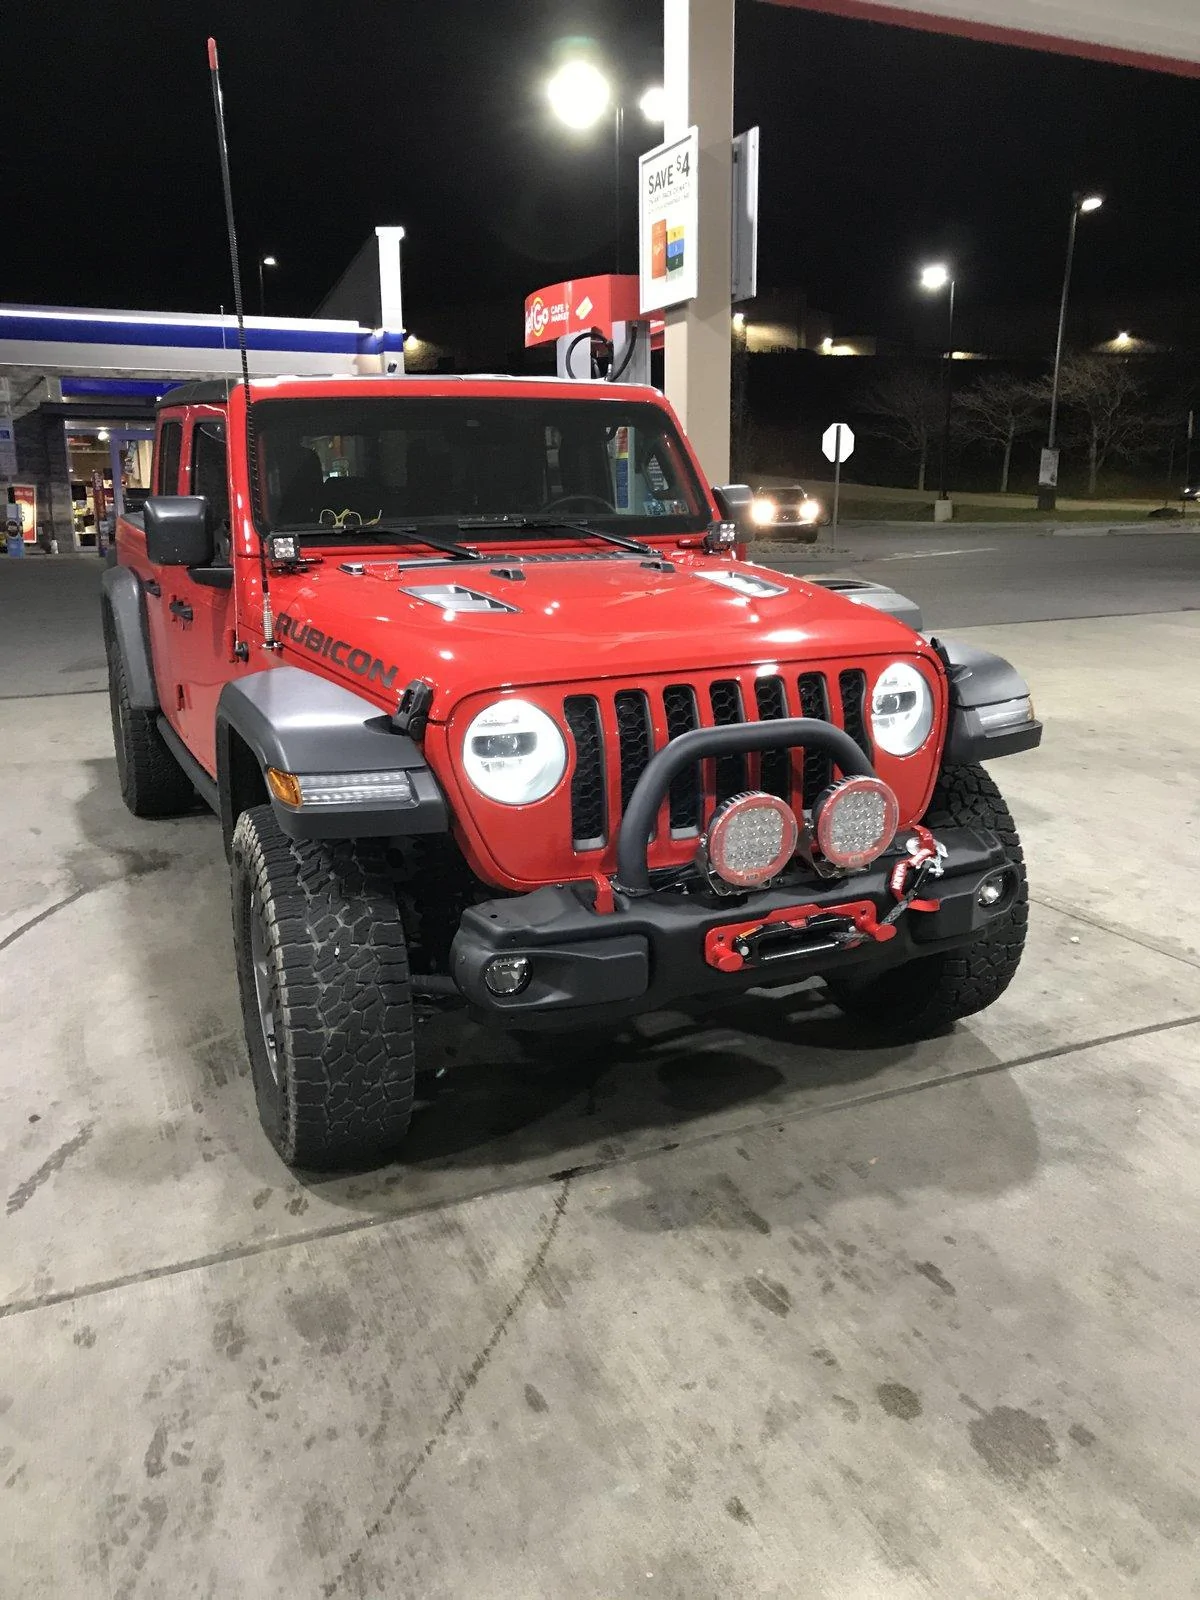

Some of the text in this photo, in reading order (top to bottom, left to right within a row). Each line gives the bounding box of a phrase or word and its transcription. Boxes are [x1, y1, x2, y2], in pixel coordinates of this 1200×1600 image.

[648, 164, 673, 195] SAVE
[676, 151, 690, 177] $4
[275, 612, 400, 690] RUBICON
